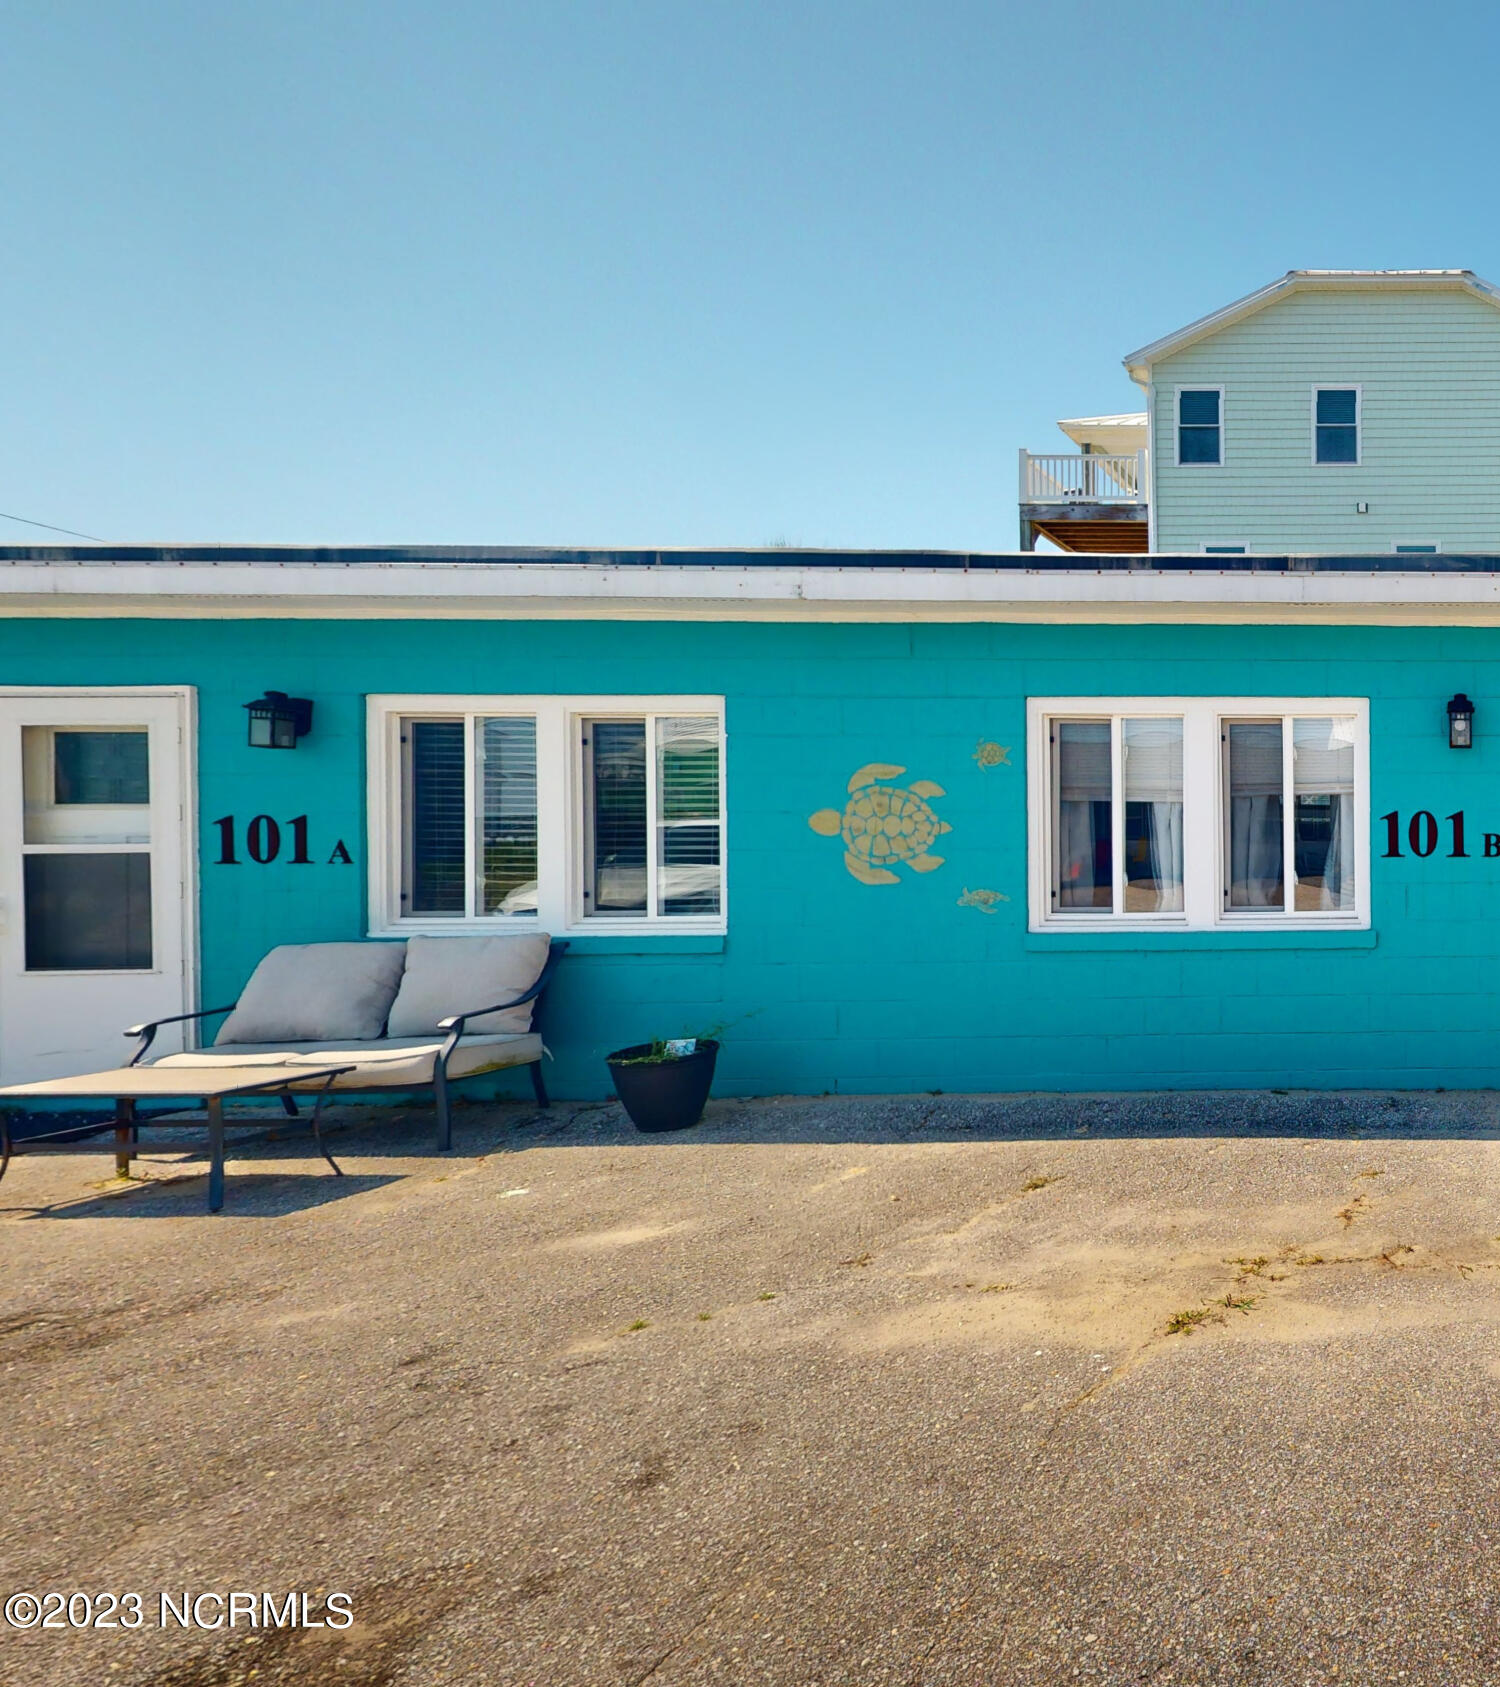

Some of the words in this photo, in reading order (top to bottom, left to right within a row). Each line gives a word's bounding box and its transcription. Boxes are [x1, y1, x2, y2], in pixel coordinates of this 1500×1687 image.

[212, 814, 315, 865] 101
[327, 839, 355, 865] A
[1379, 811, 1471, 858] 101
